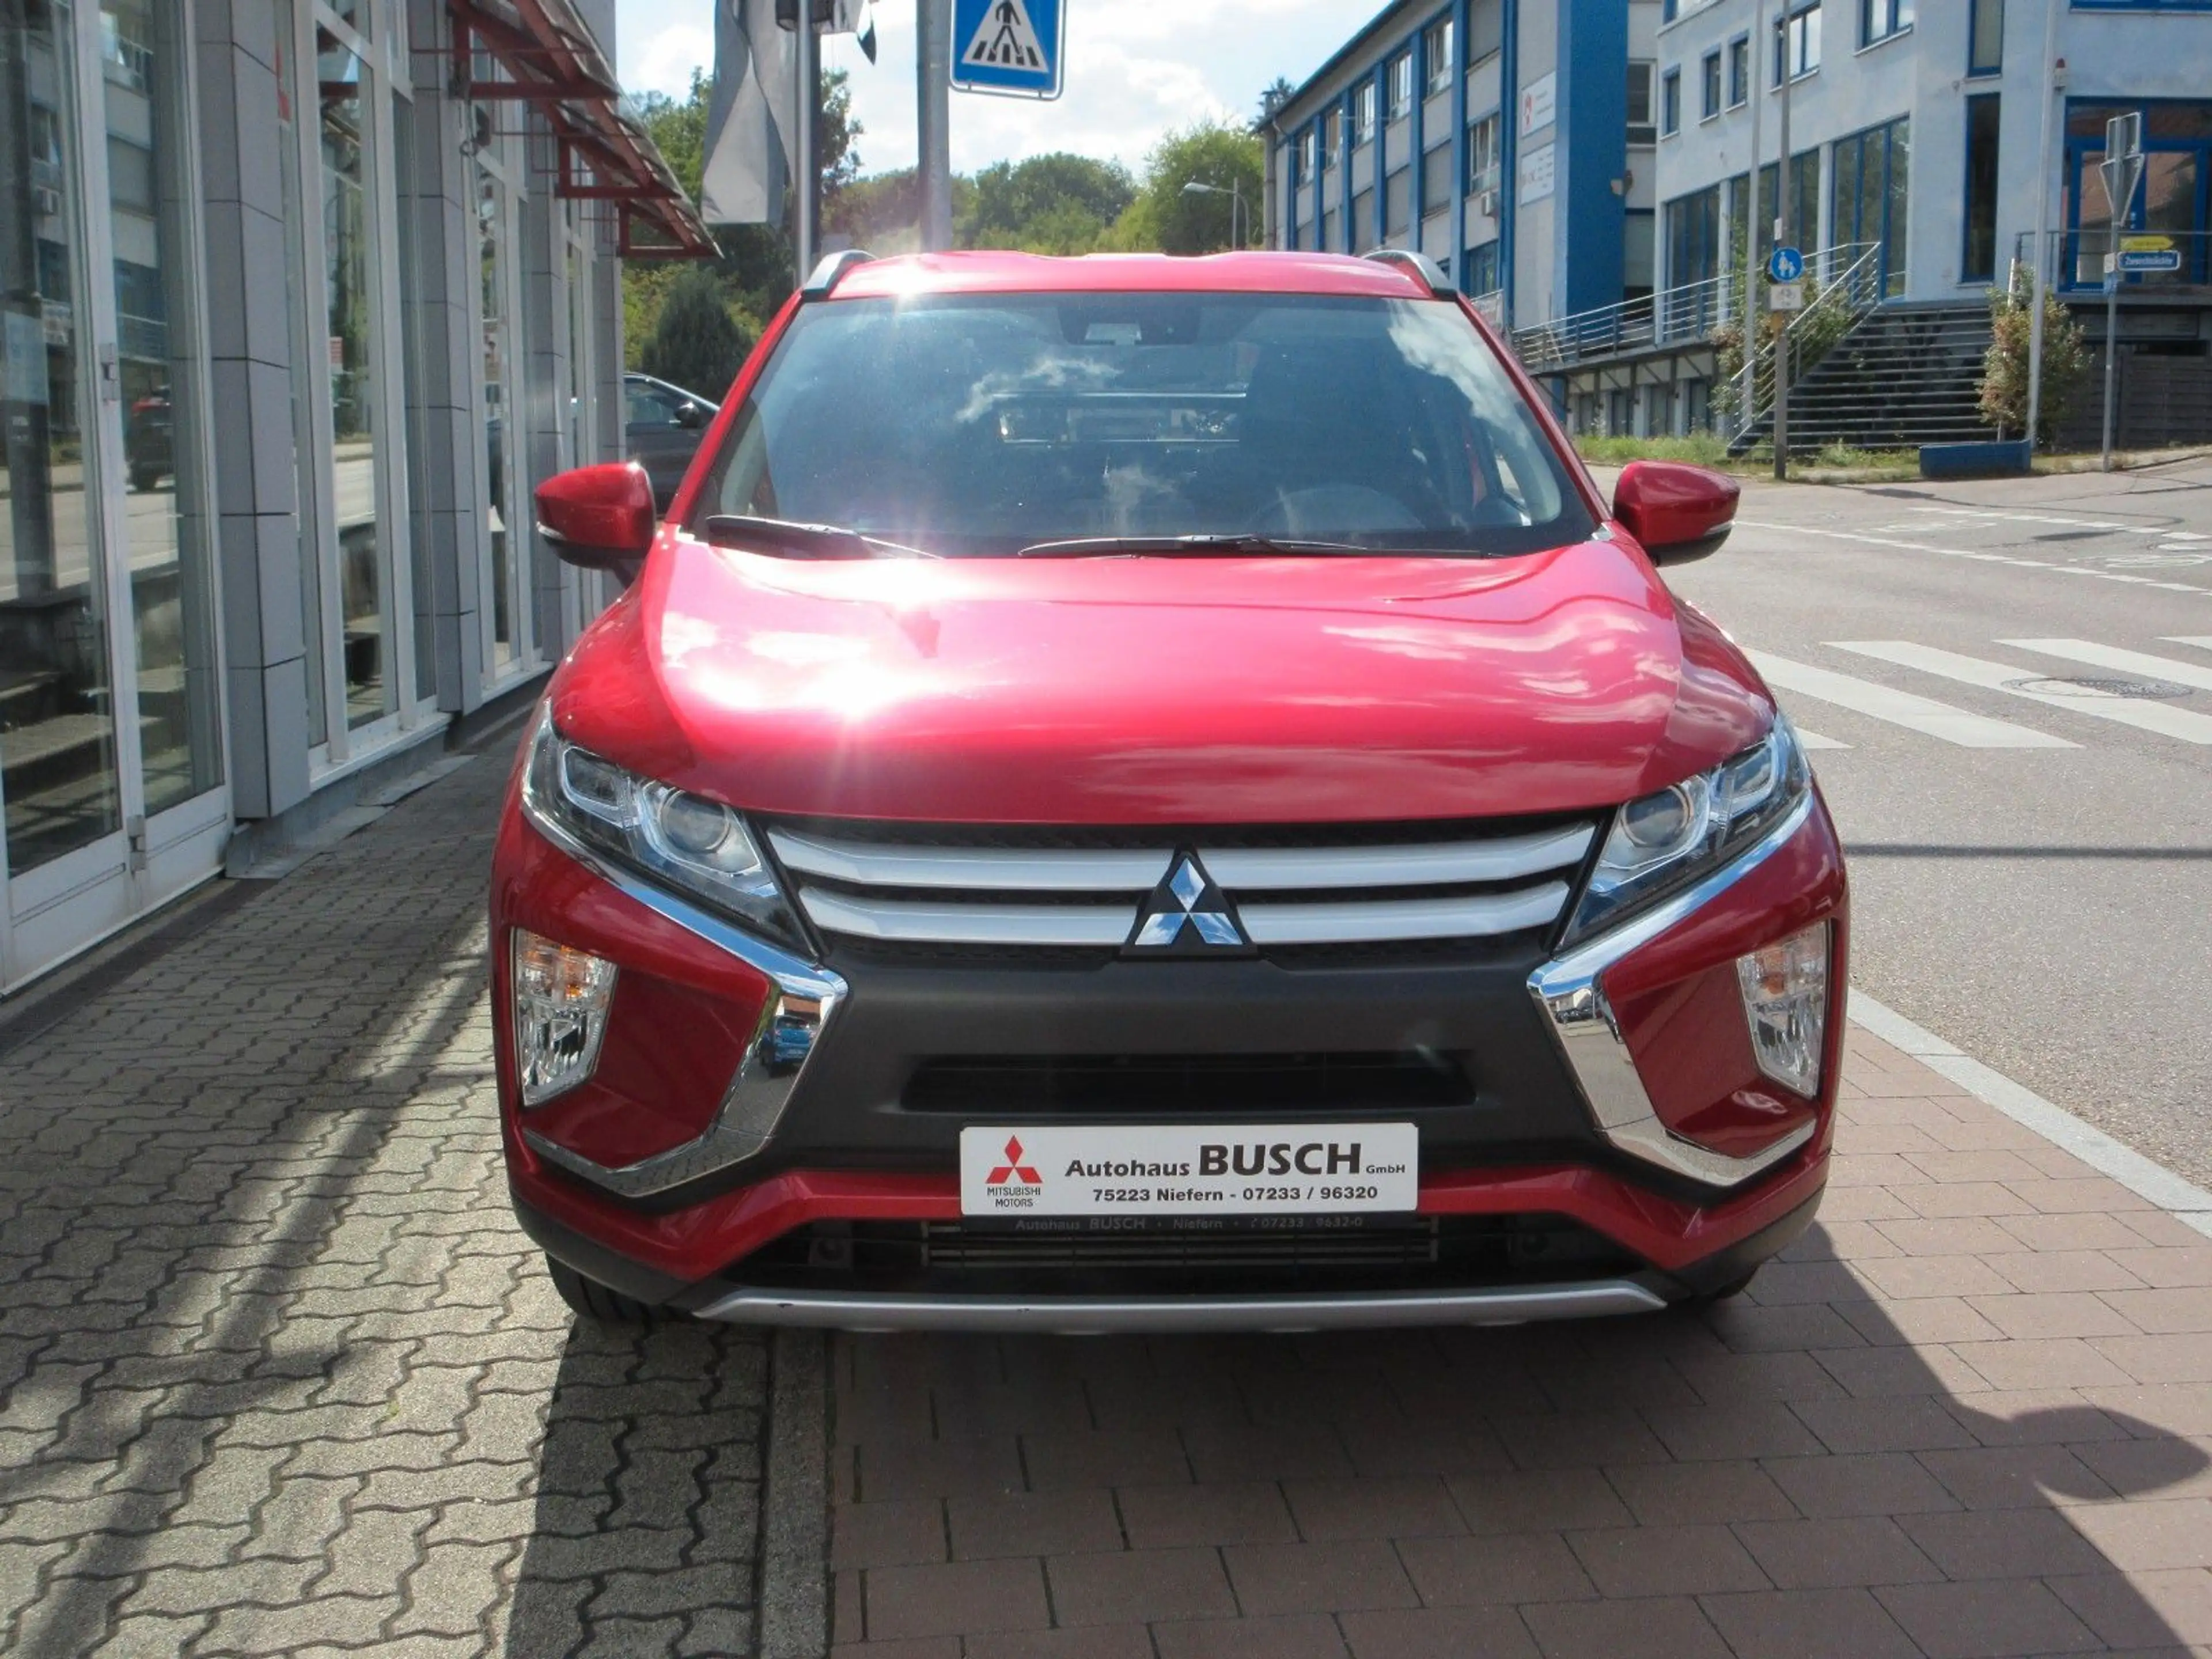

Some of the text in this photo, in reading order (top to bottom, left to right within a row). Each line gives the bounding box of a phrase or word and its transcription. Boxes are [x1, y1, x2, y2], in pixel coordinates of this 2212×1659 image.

[1065, 1143, 1406, 1177] Autohaus BUSCH GmbH
[987, 1187, 1041, 1196] MITSUBISHI
[1093, 1188, 1150, 1202] 75223
[1156, 1187, 1224, 1201] Niefern
[1243, 1187, 1301, 1200] 07233
[1306, 1186, 1314, 1200] /
[1320, 1185, 1378, 1200] 96320
[995, 1198, 1034, 1207] MOTORS
[1015, 1218, 1081, 1231] Autohaus
[1089, 1217, 1146, 1230] BUSCH
[1172, 1218, 1223, 1229] Niefern
